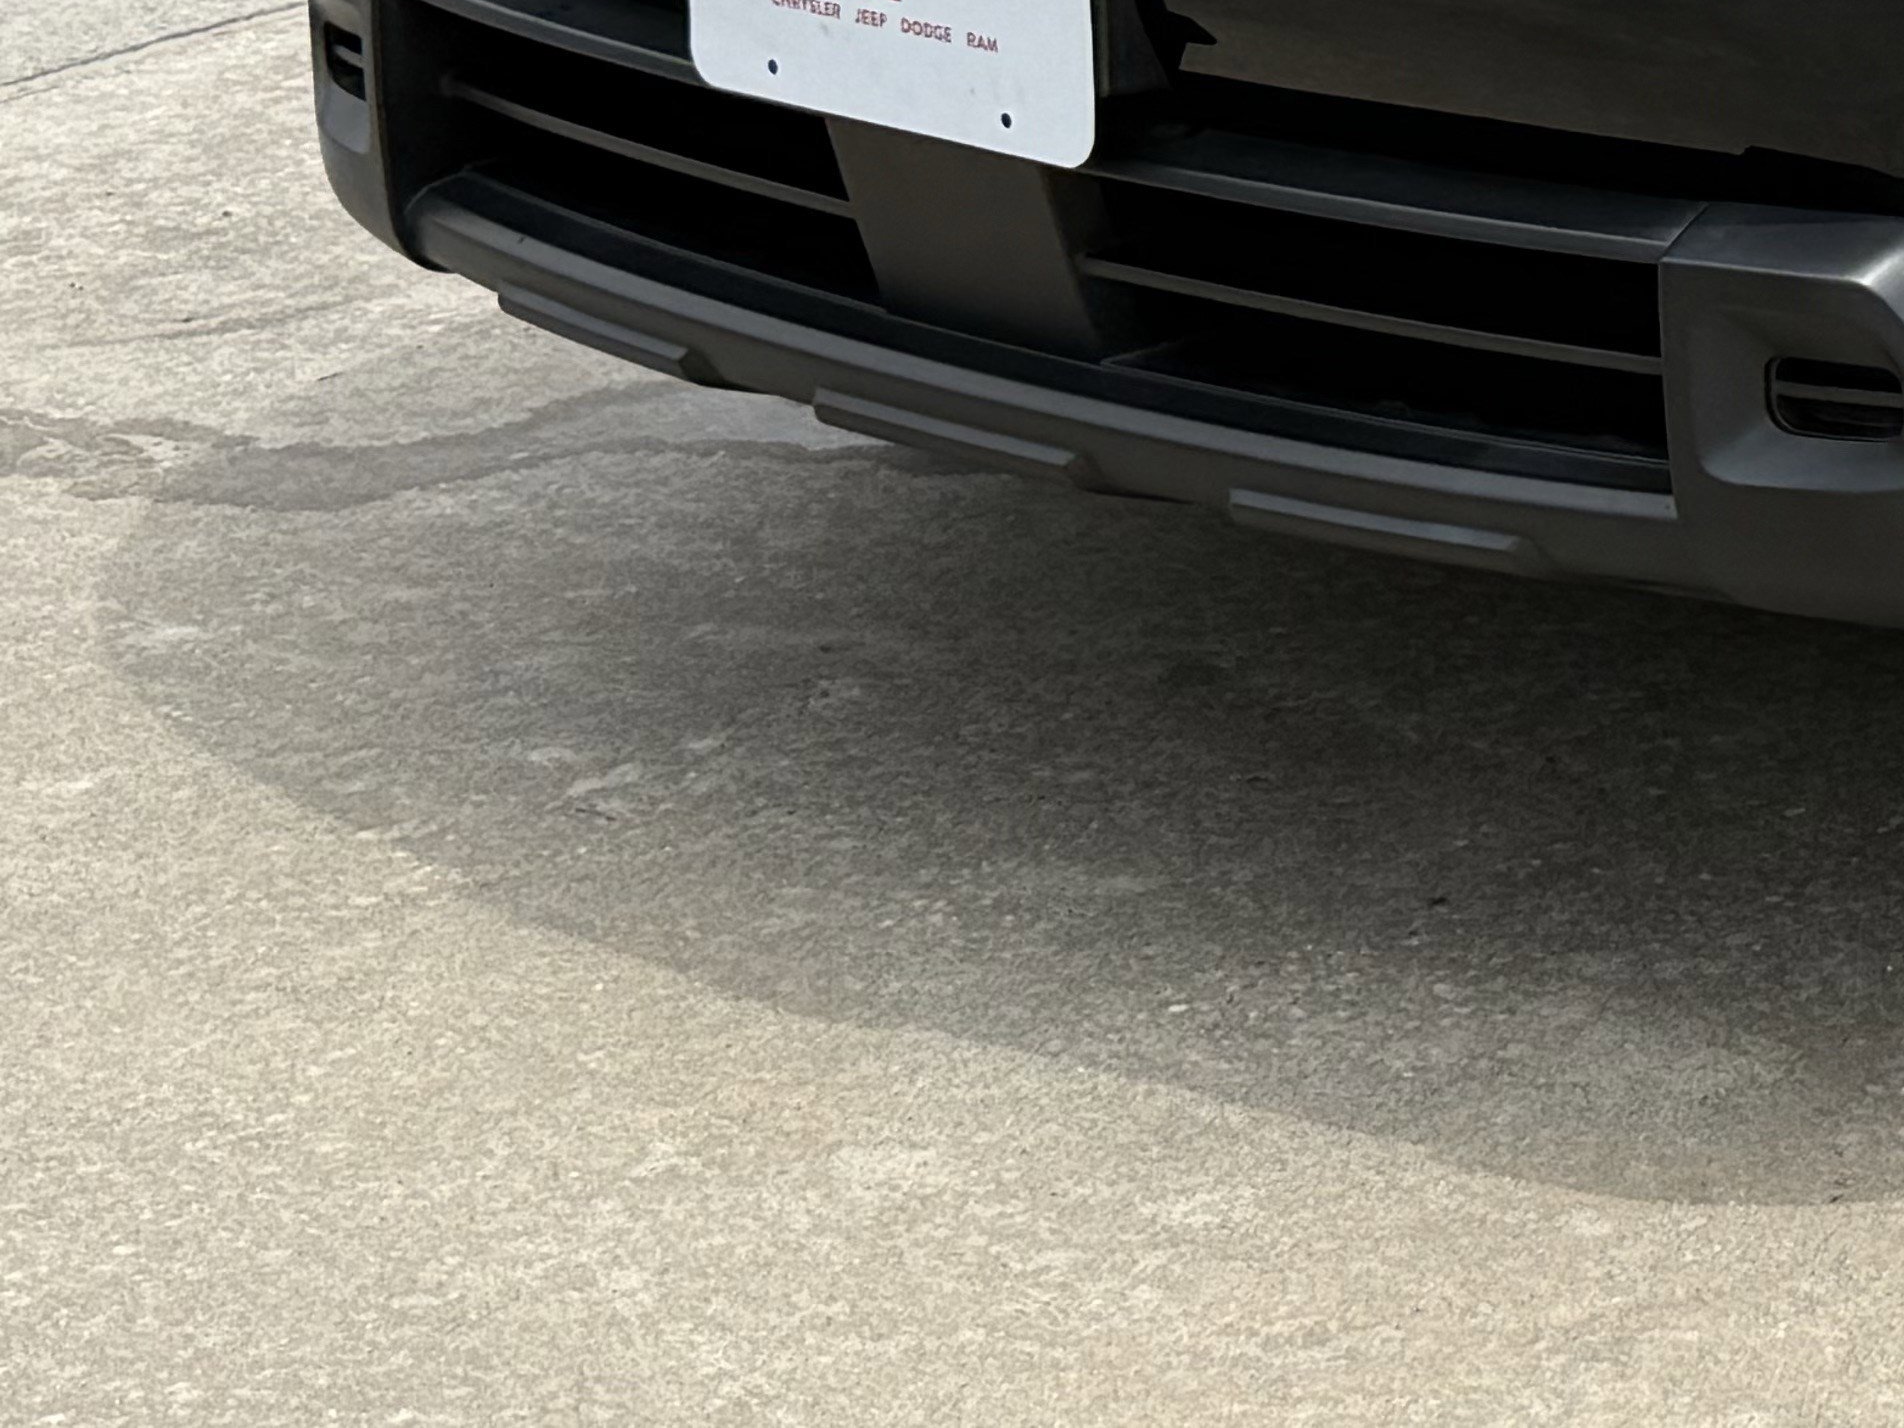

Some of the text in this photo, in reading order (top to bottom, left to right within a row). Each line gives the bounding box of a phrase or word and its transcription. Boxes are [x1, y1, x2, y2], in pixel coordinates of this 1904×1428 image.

[855, 7, 888, 29] JEEP
[900, 17, 952, 44] DODGE
[966, 32, 999, 54] RAM
